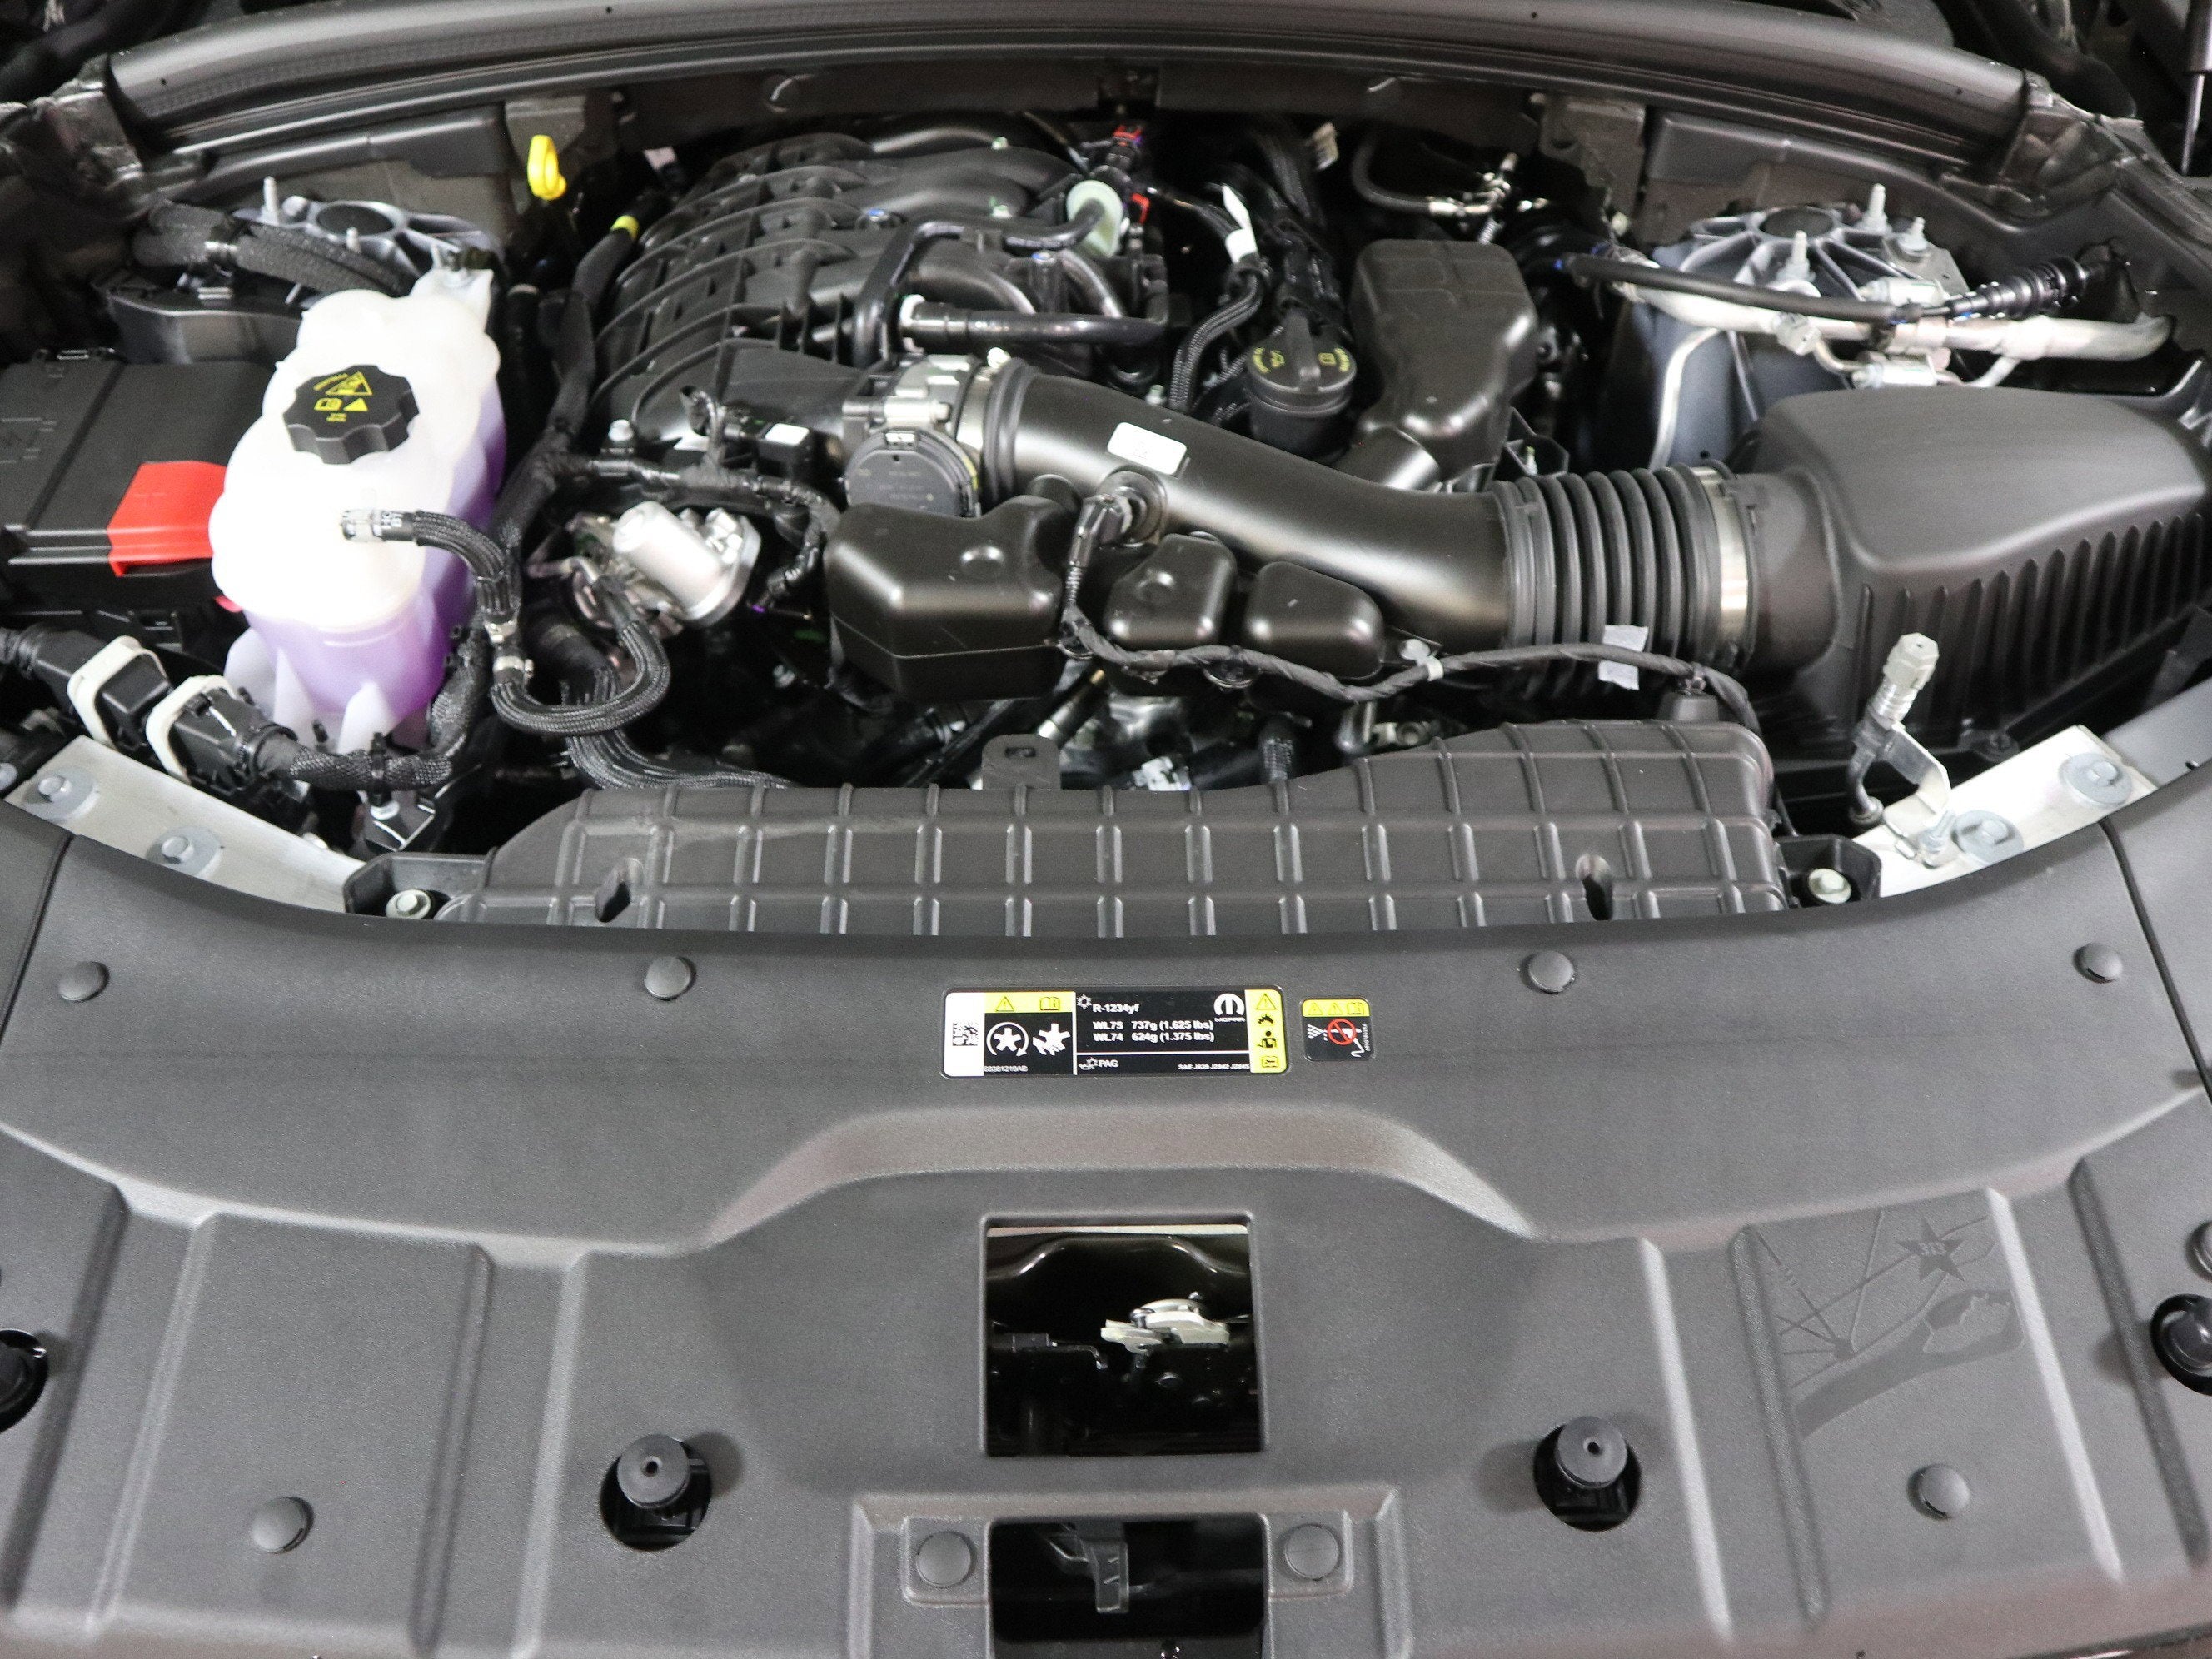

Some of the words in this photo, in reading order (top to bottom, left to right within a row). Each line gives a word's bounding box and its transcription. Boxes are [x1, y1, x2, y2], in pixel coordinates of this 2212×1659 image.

[1092, 1003, 1140, 1014] R-1234yf
[1092, 1020, 1124, 1030] WL75
[1131, 1020, 1158, 1031] 737g
[1159, 1020, 1192, 1031] (1.625
[1193, 1020, 1214, 1030] lbs)
[1093, 1032, 1124, 1042] WL74
[1131, 1032, 1158, 1043] 624g
[1159, 1032, 1193, 1043] (1.375
[1194, 1032, 1215, 1042] lbs)
[1099, 1059, 1119, 1068] PAG
